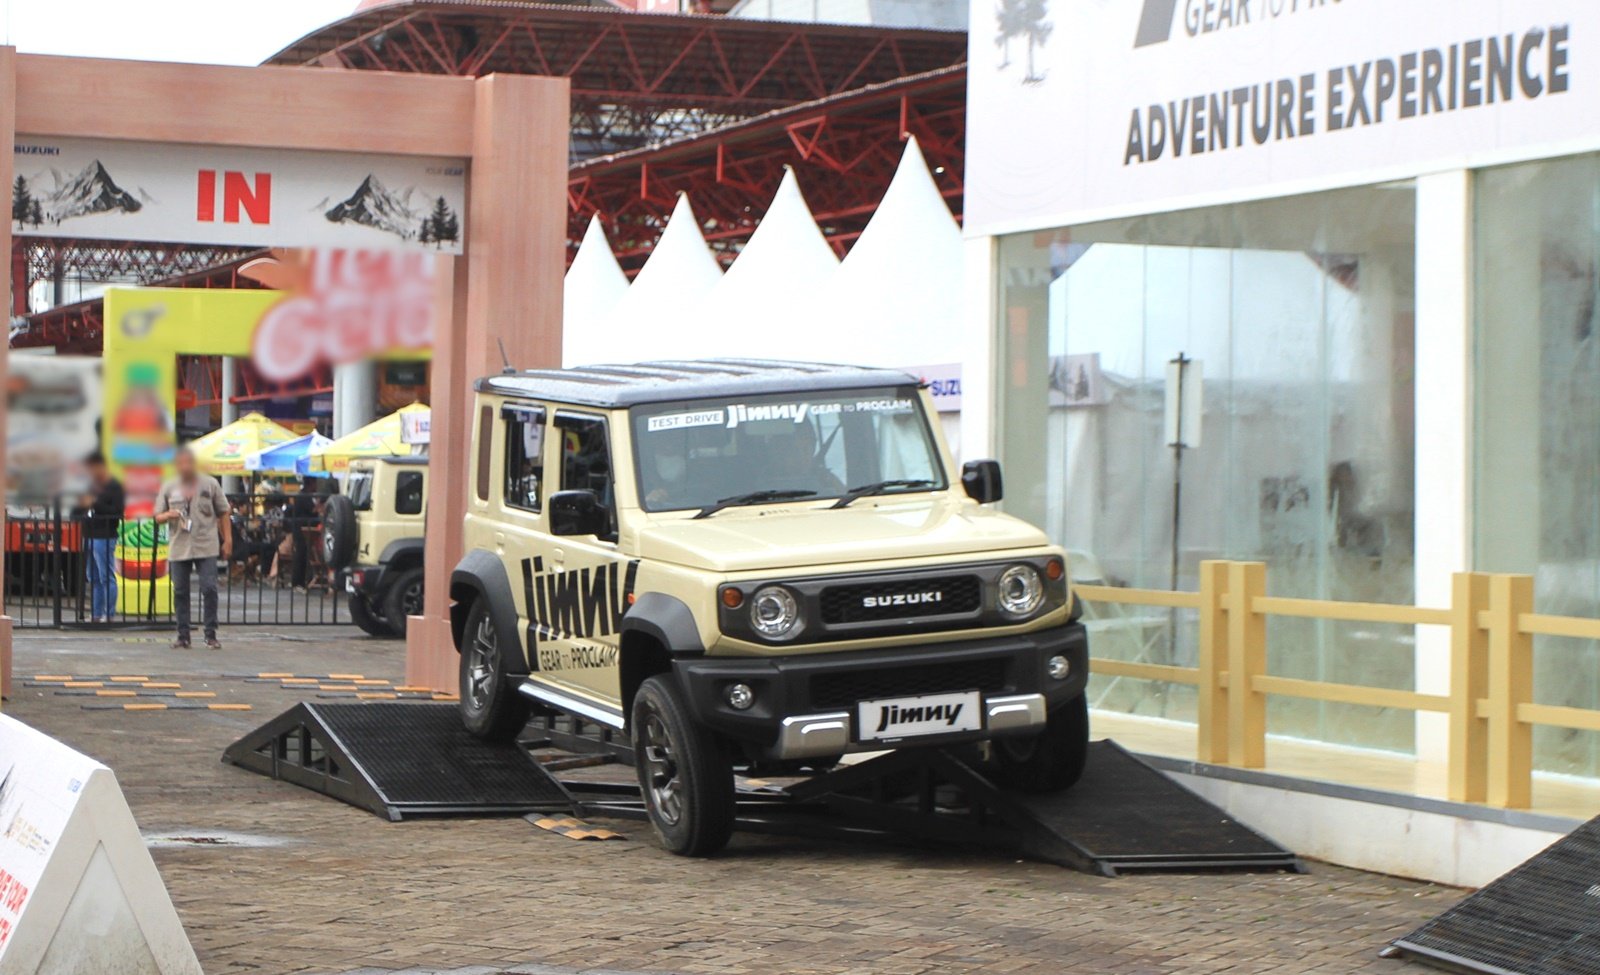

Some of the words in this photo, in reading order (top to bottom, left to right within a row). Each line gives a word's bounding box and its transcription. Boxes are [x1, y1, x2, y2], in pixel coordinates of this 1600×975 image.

[1184, 0, 1250, 37] GEAR
[1124, 73, 1314, 166] ADVENTURE
[1326, 23, 1571, 133] EXPERIENCE
[197, 169, 271, 225] IN
[931, 379, 962, 397] SUZ
[652, 416, 680, 428] TEST
[685, 413, 720, 425] DRIVE
[726, 403, 809, 429] Jimny
[811, 403, 842, 415] GEAR
[856, 399, 912, 412] PROCLAIM
[862, 591, 943, 607] SUZUKI
[540, 650, 562, 671] GEAR
[571, 645, 618, 669] PROCLAIM
[876, 703, 964, 732] Jimny
